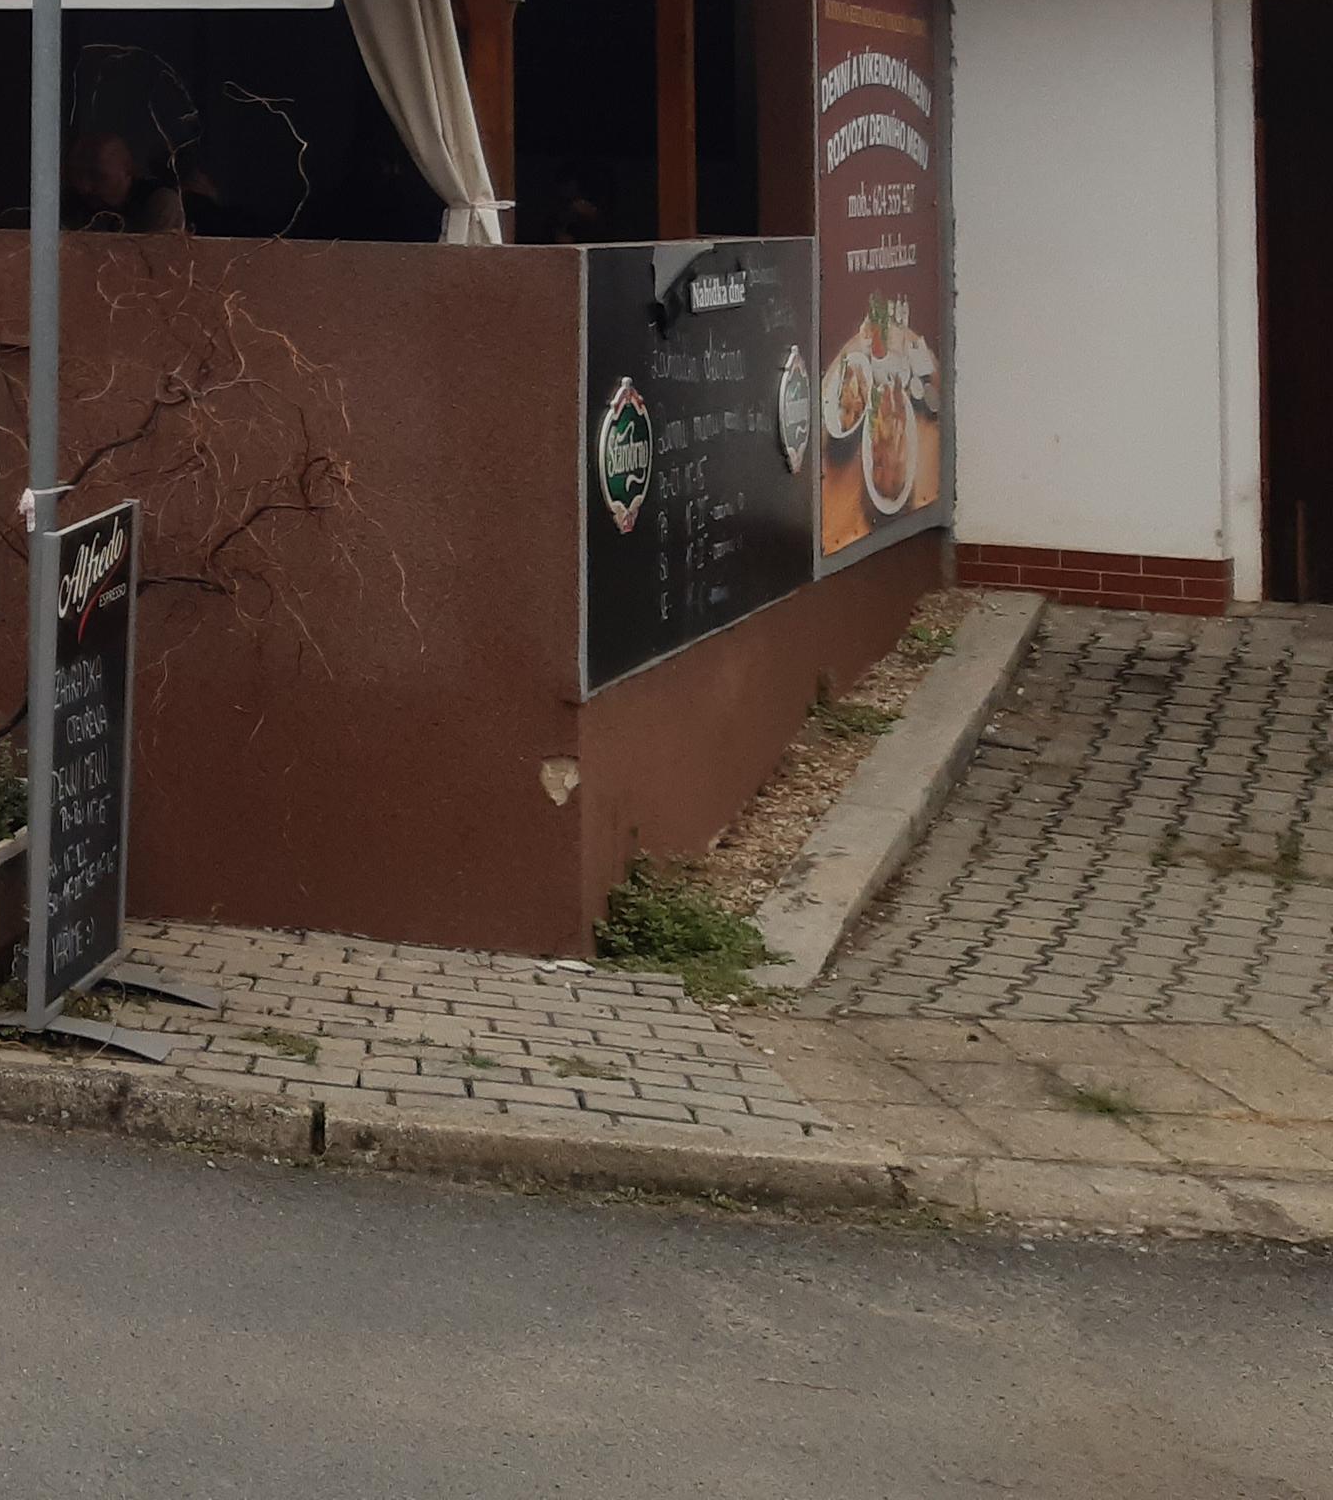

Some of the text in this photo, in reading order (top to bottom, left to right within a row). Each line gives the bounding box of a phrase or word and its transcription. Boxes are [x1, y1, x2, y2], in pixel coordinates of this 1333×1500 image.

[822, 46, 932, 118] DENNÍ A VÍKENDOVÁ MENU
[826, 114, 869, 174] ROZVOZY
[692, 276, 727, 310] Nabídka
[58, 516, 124, 619] Alfredo
